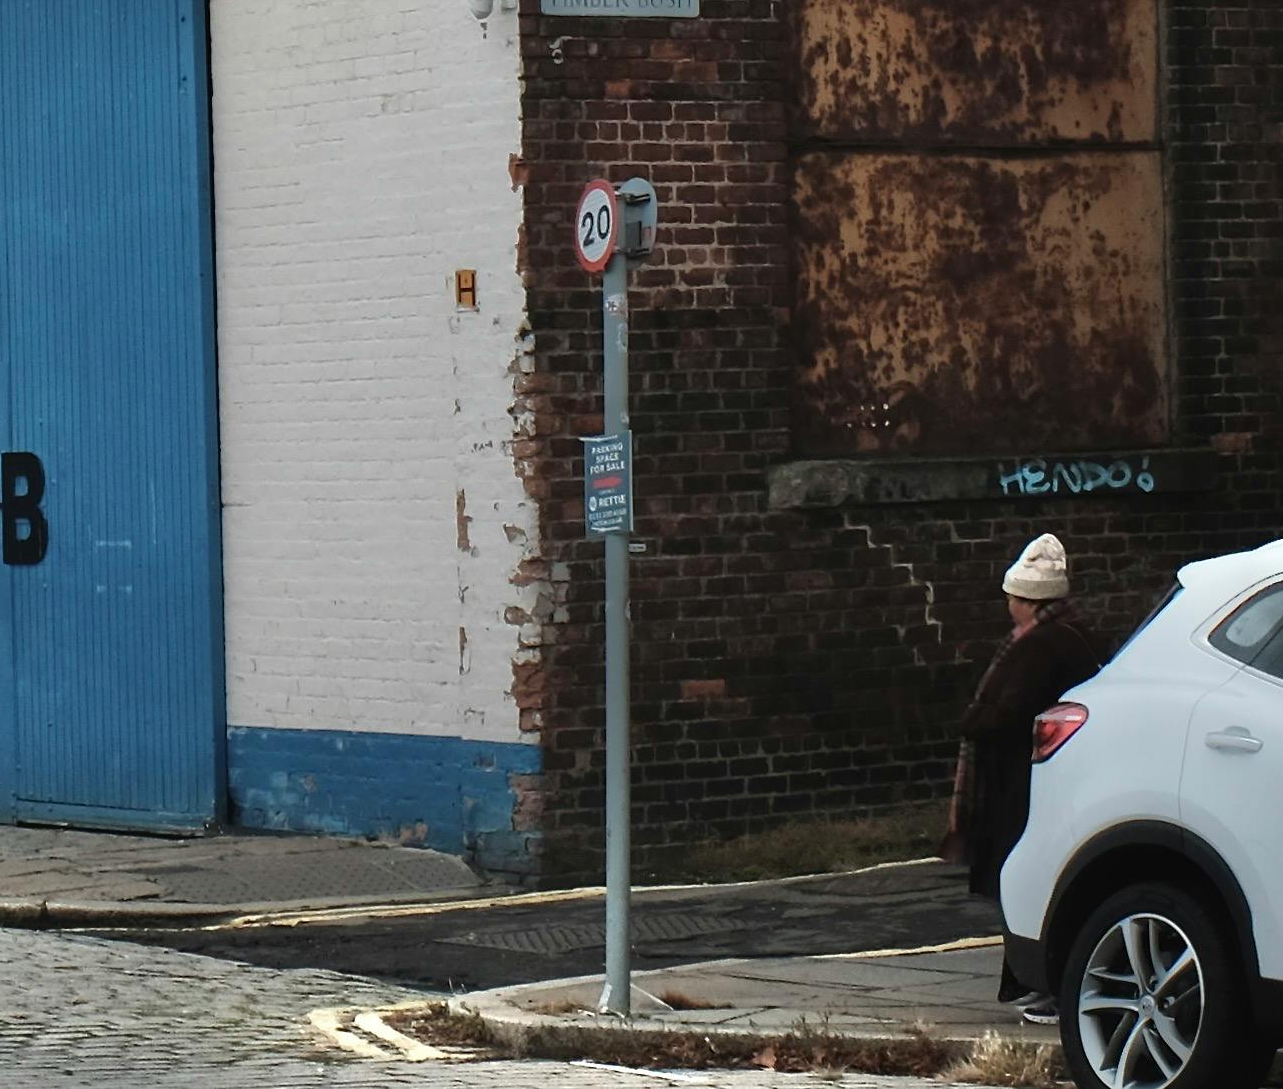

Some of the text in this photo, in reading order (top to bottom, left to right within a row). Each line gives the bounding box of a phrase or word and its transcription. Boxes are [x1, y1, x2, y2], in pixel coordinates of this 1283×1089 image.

[581, 204, 611, 247] 20
[457, 272, 476, 307] H
[589, 461, 625, 475] FOR SALE
[595, 452, 619, 464] SPACE
